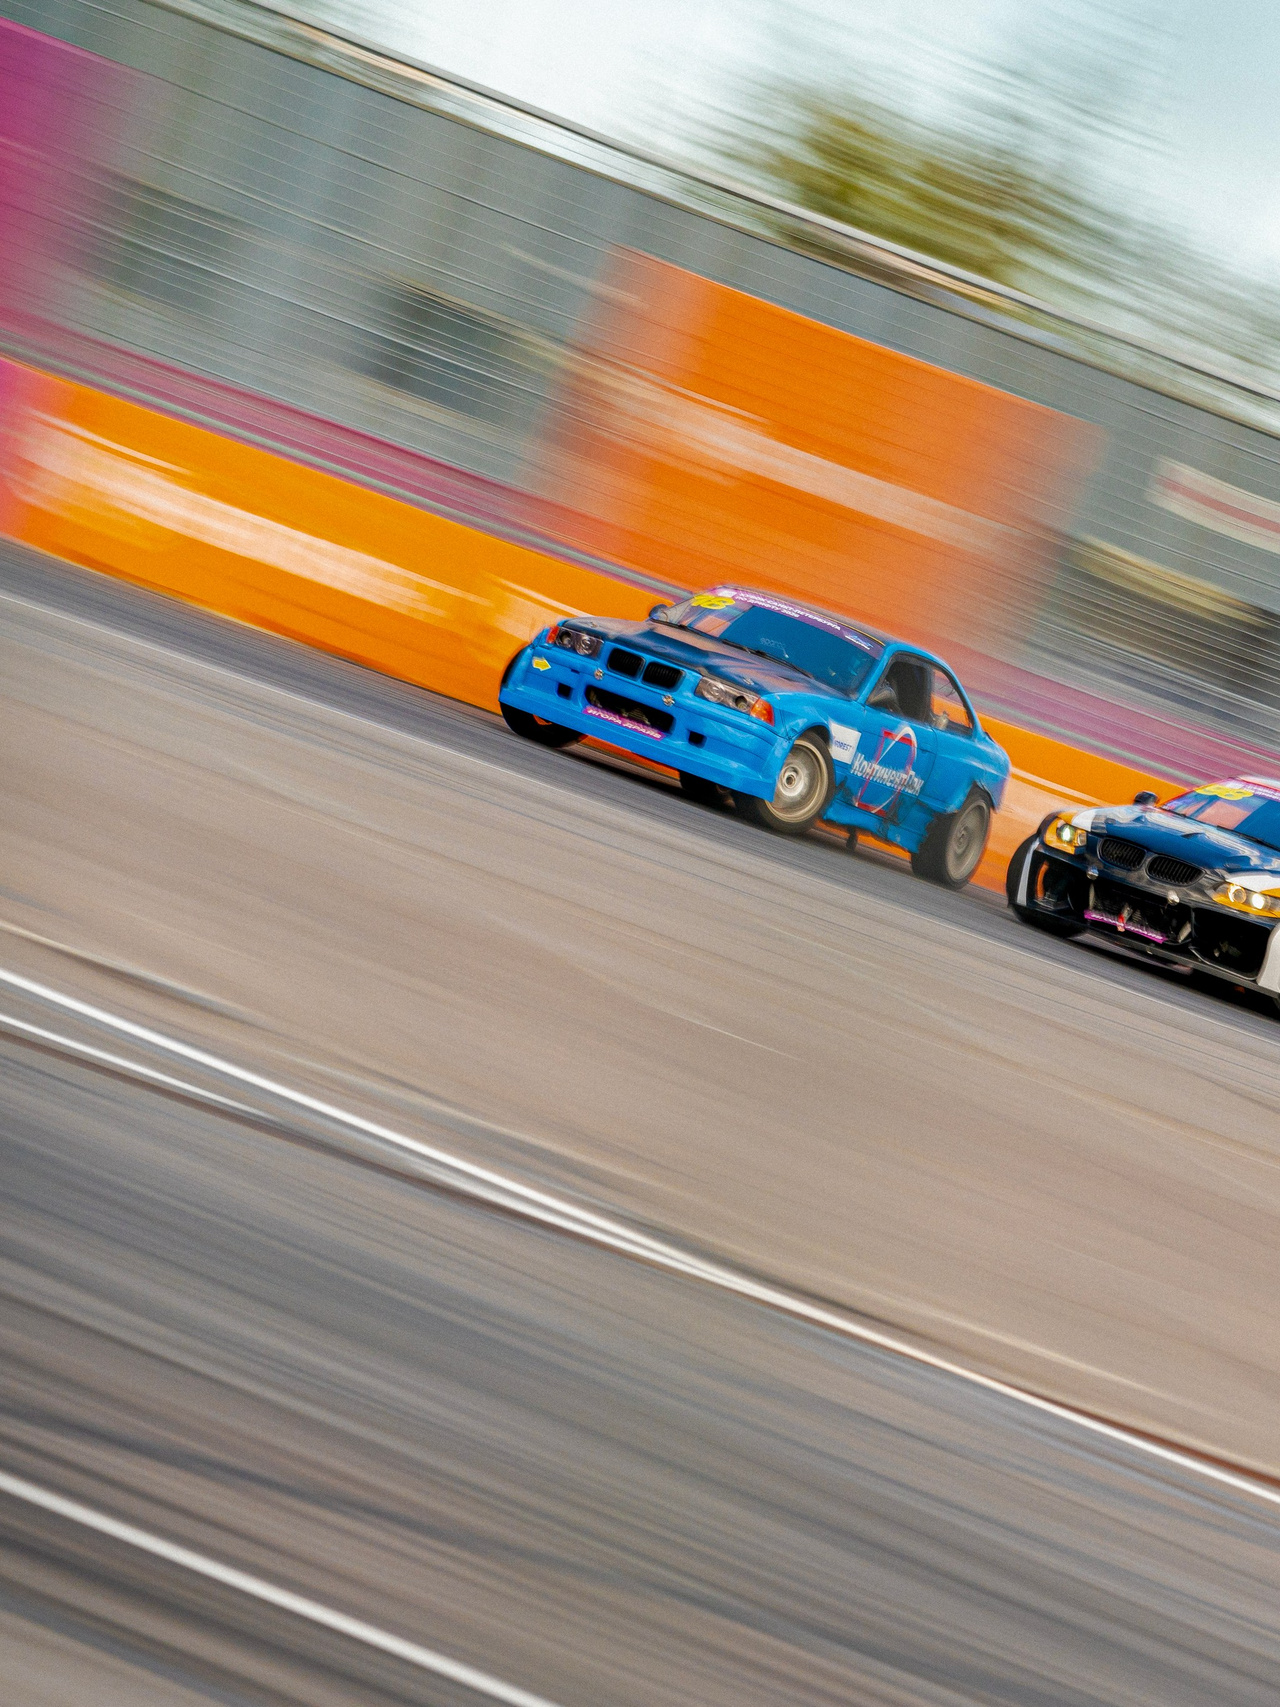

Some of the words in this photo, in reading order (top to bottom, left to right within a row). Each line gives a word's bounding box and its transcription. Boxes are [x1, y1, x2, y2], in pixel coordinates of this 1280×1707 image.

[768, 599, 841, 631] САНКТ-ПЕТЕРБУРГА
[587, 709, 622, 725] ИГОРА
[622, 722, 662, 739] ДРАЙВ
